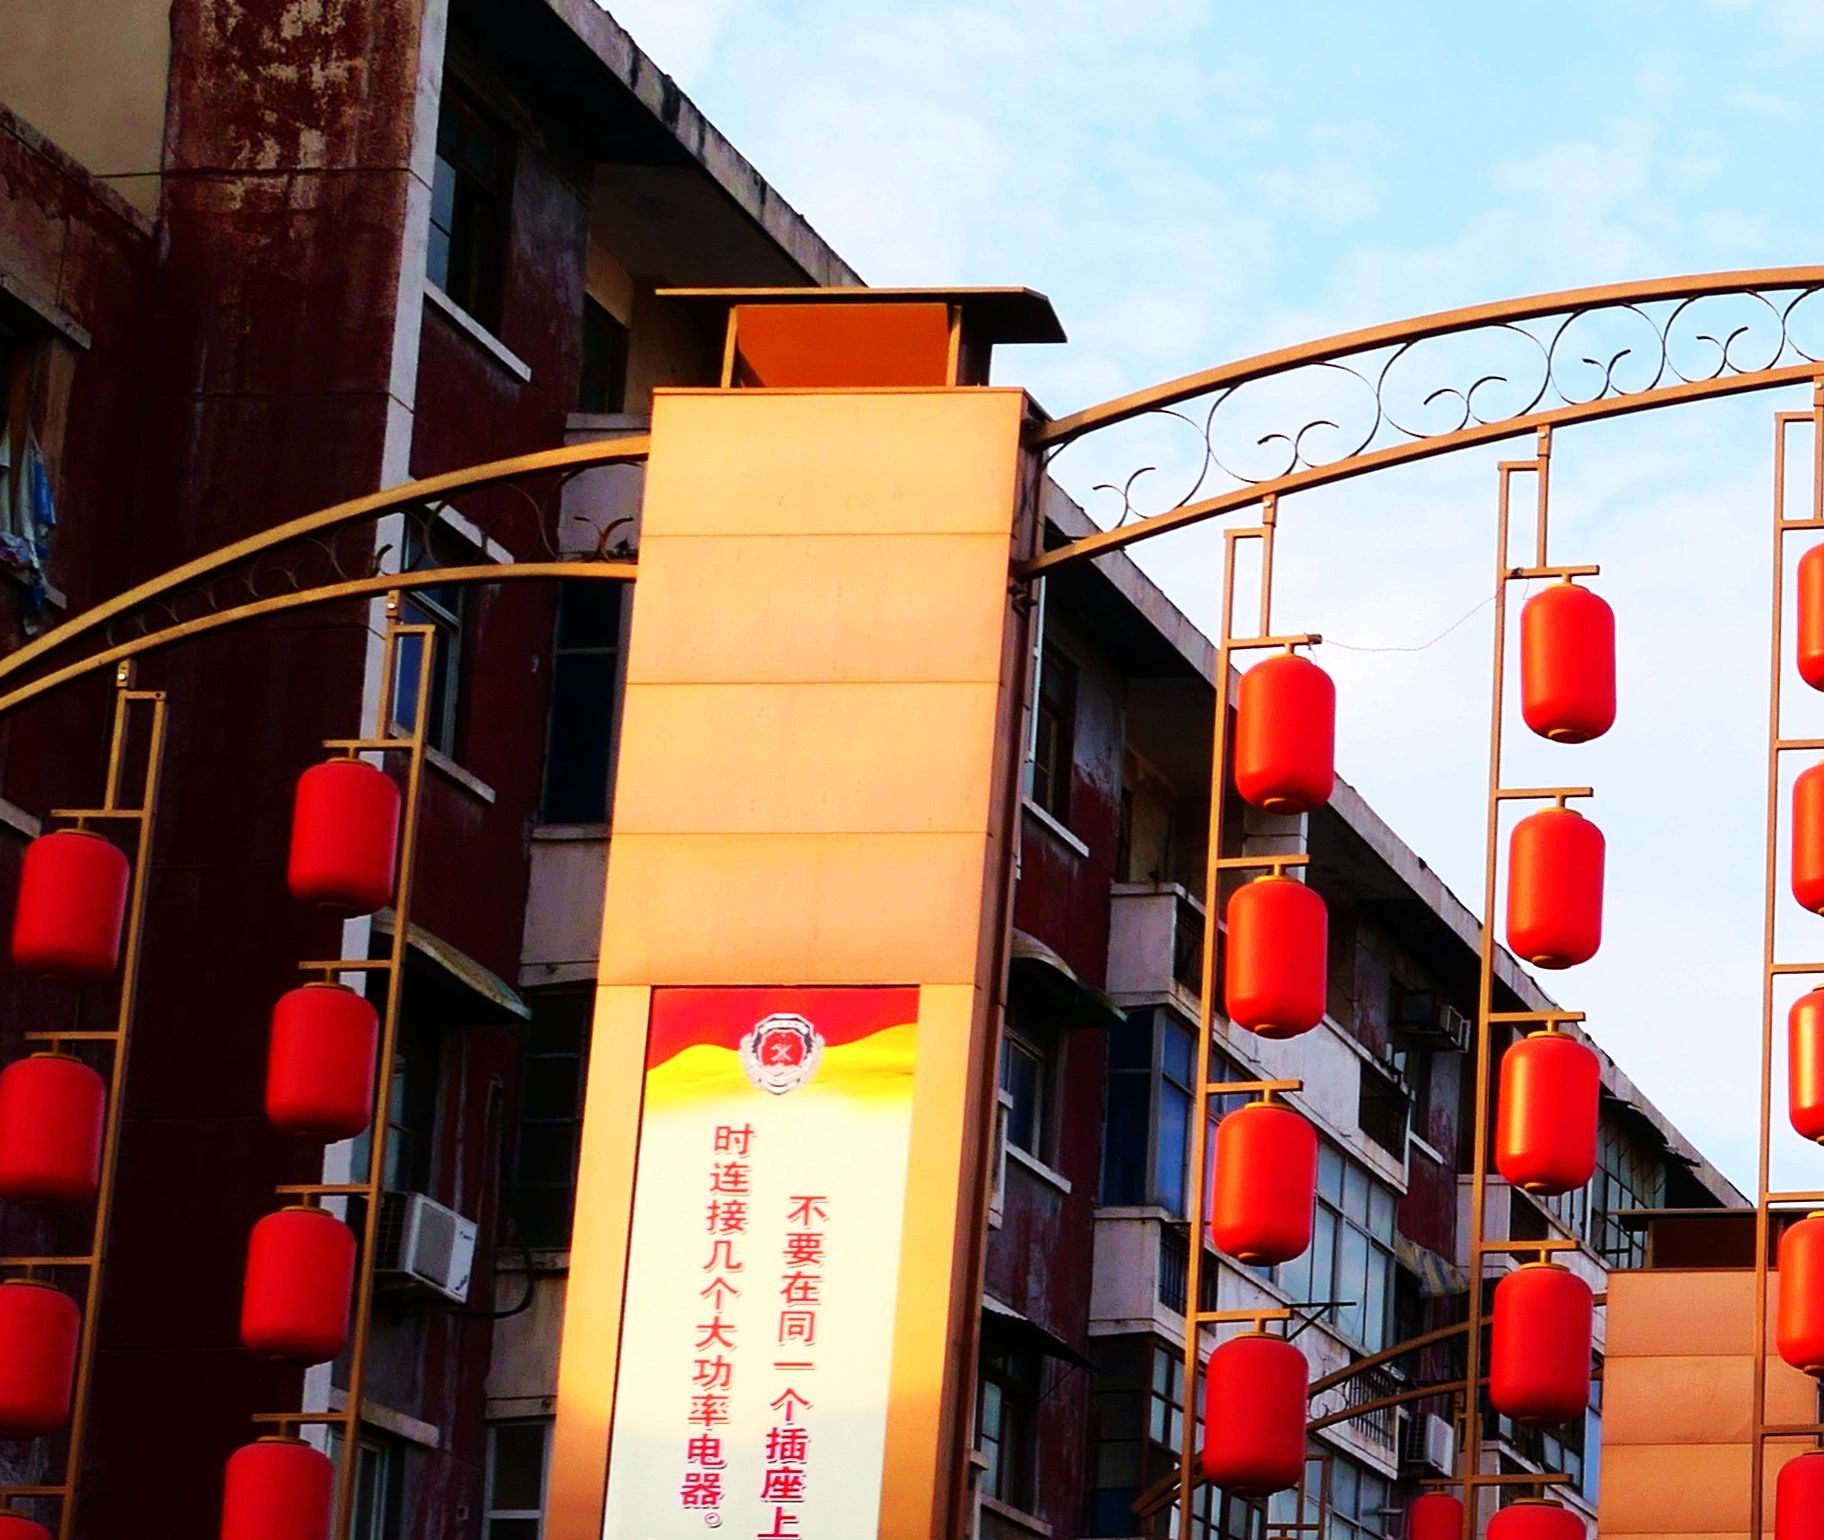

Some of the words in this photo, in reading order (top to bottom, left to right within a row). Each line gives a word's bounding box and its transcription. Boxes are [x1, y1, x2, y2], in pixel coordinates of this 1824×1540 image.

[680, 1123, 754, 1527] 时连接几个大功率电器。
